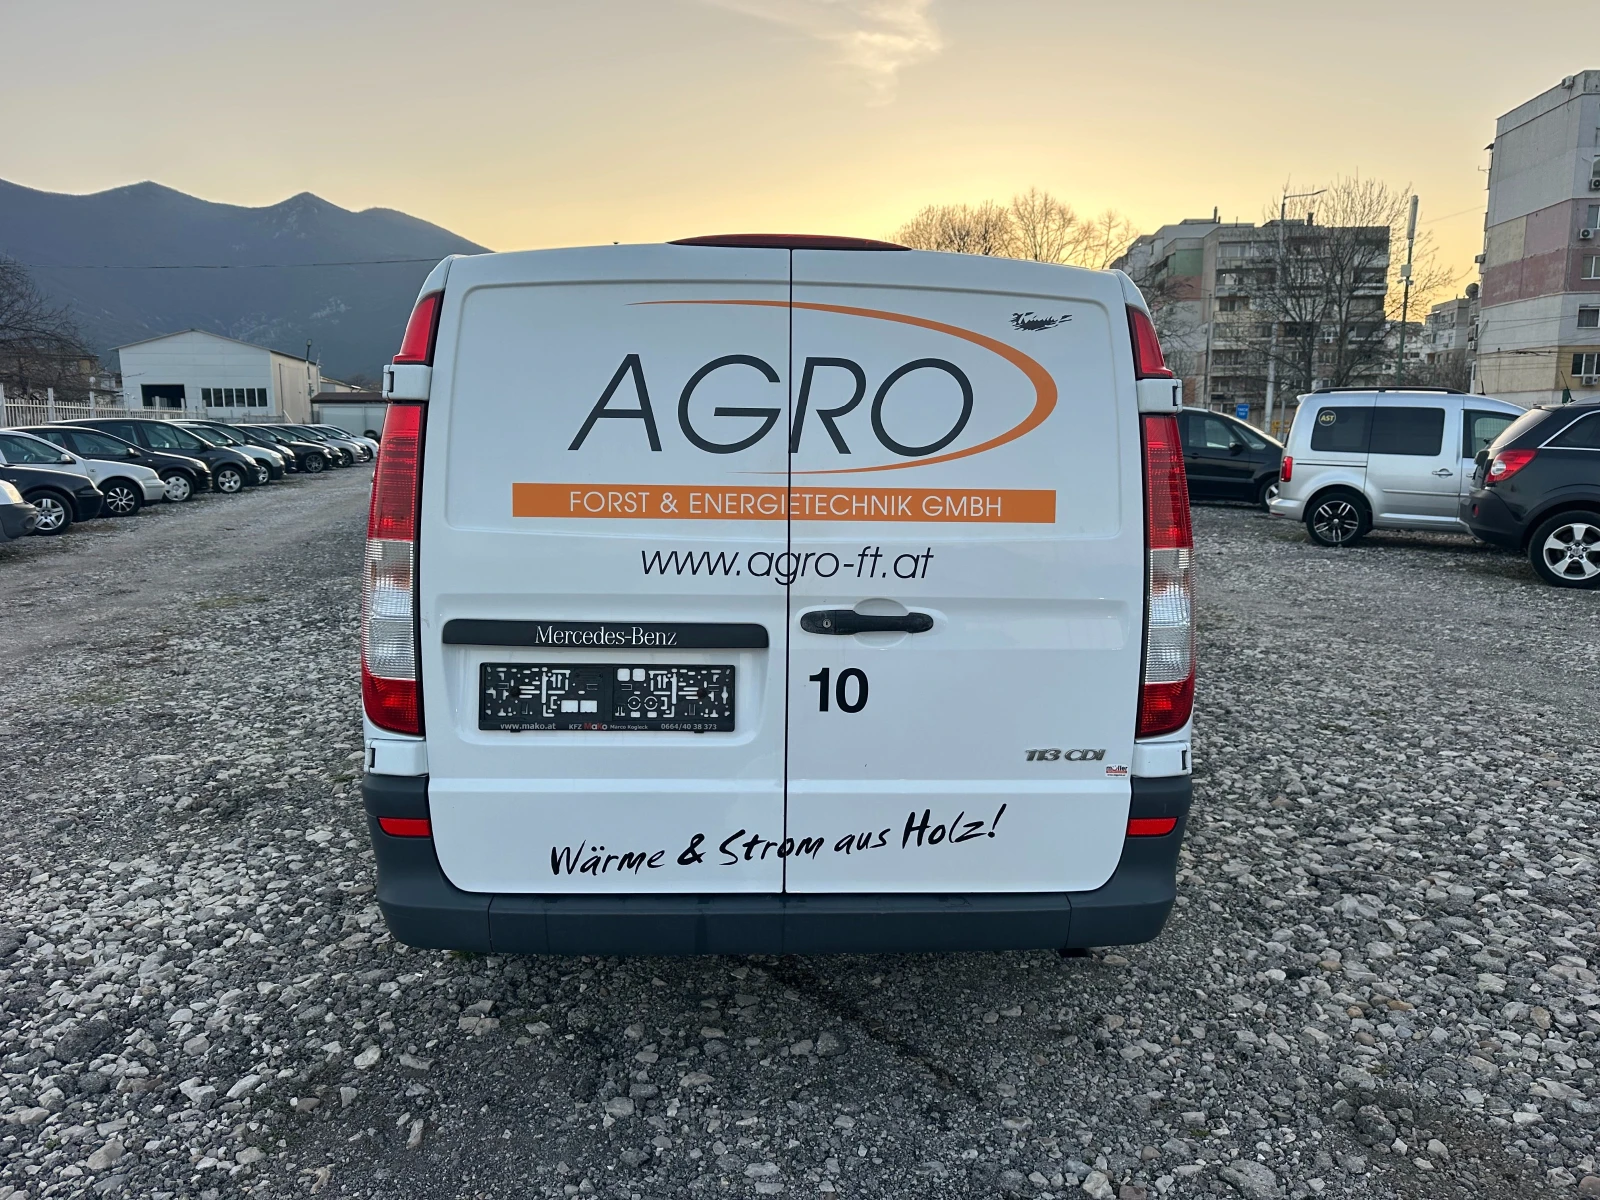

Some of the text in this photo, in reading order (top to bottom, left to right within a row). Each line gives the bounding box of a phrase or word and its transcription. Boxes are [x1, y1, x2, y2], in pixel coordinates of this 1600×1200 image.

[567, 353, 974, 457] AGRO
[569, 491, 1002, 518] FORST & ENERGIETECHNIK GMBH
[640, 546, 935, 586] www.agro-ft.at
[534, 625, 678, 647] Mercedes-Benz
[809, 666, 870, 714] 10
[1025, 748, 1107, 761] 113 CDI
[550, 803, 1008, 876] Wärme & Strom aus Holz!
